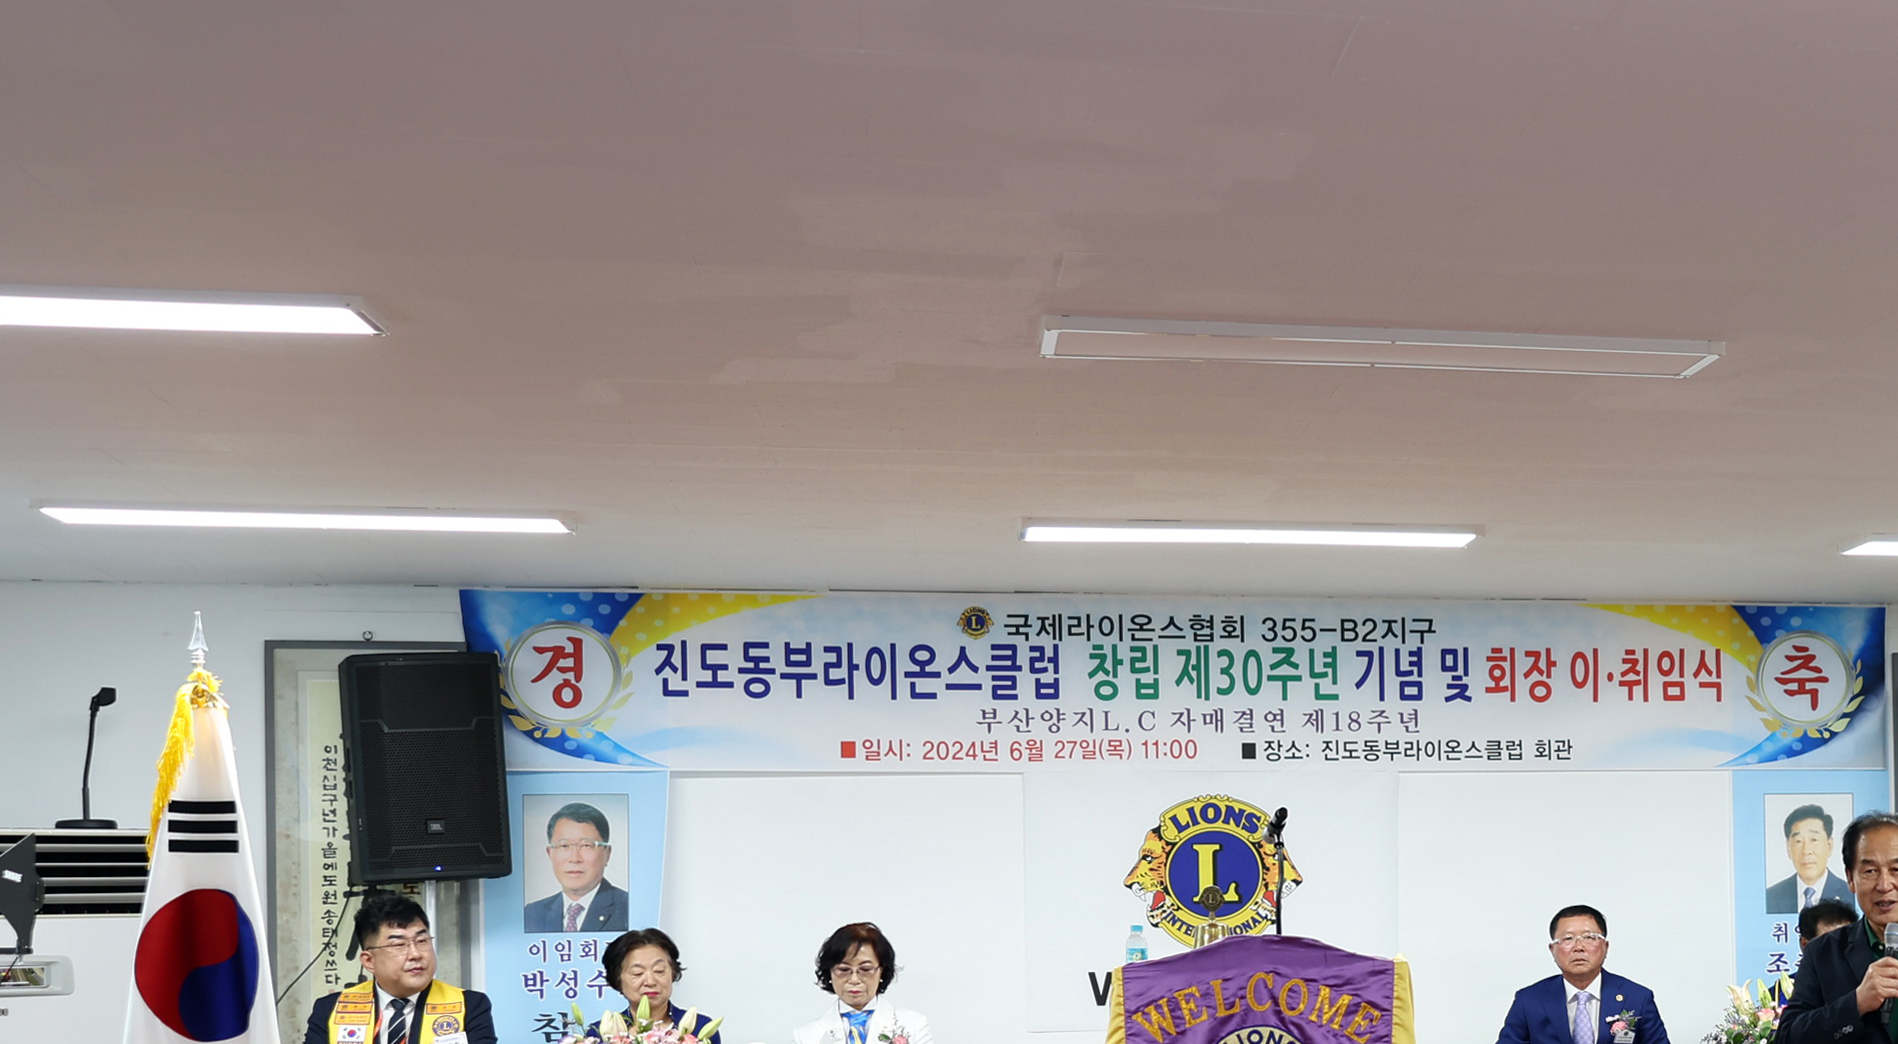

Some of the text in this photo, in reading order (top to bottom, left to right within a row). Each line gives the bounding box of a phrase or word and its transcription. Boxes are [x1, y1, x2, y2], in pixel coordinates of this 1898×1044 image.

[1003, 612, 1438, 645] 국제라이온스협회 355-B2지구
[530, 635, 587, 710] 경
[653, 639, 1724, 703] 진도동부라이온스클럽 창립 제30주년 기념 및 회장 이·취임식
[1774, 643, 1830, 712] 축
[976, 707, 1422, 734] 부산양지L.C 자매결연 제18주년
[861, 738, 1199, 762] 일시: 2024년 6월 27일(목) 11:00
[1263, 738, 1574, 762] 장소: 진도동부라이온스클럽 회관
[1172, 800, 1264, 840] LIONS
[1191, 843, 1242, 903] L
[527, 938, 611, 965] 이임회
[1131, 971, 1383, 1044] WELCOME
